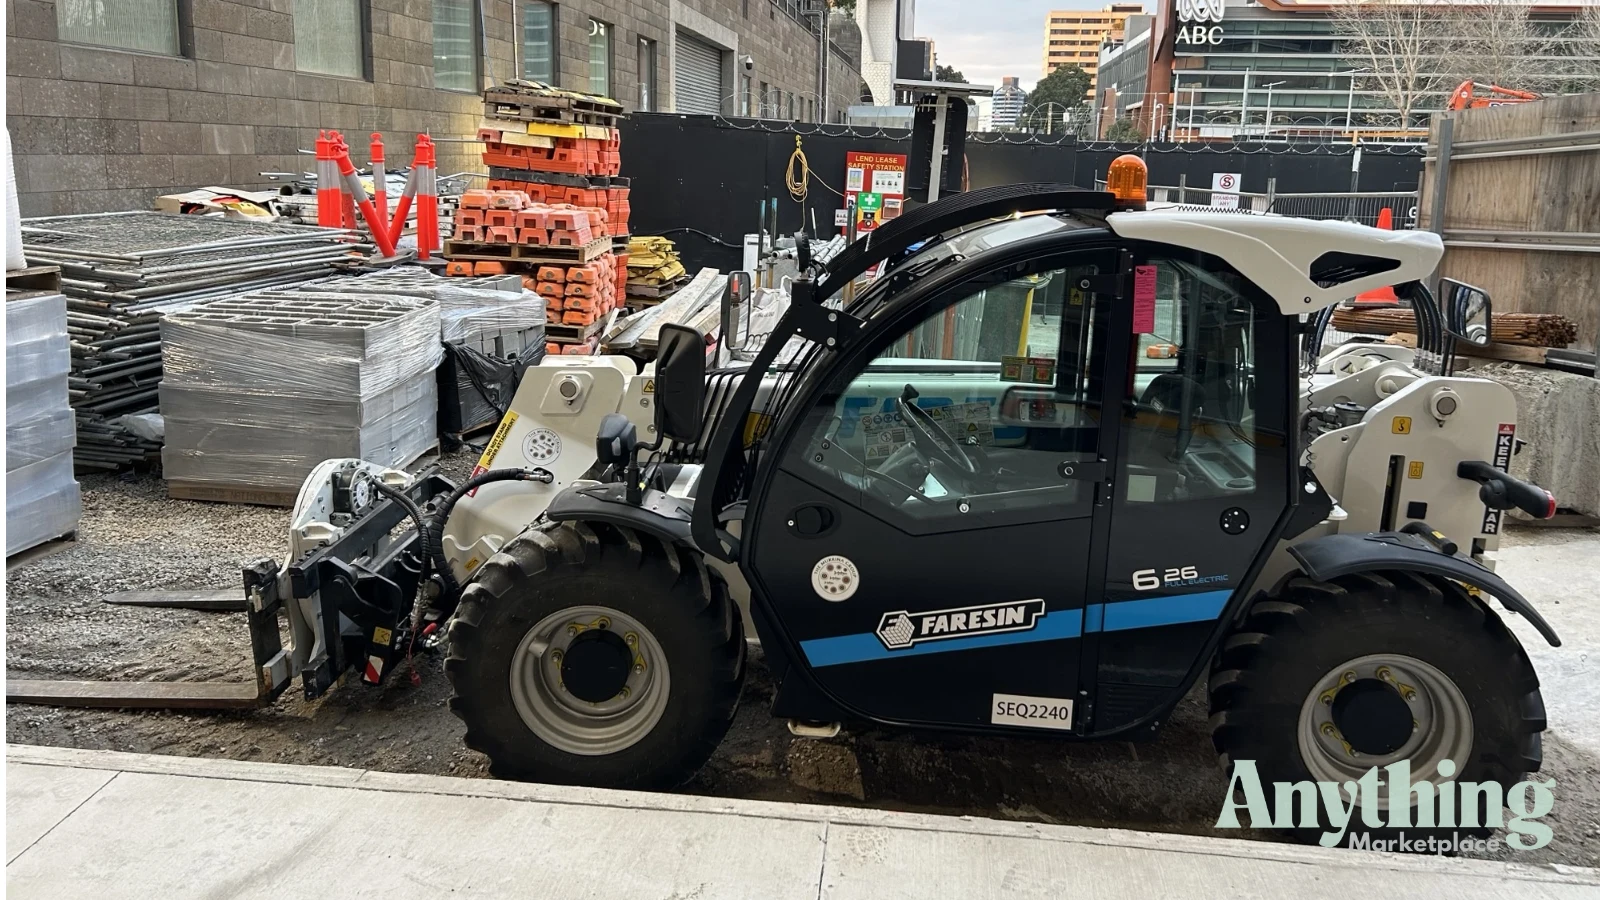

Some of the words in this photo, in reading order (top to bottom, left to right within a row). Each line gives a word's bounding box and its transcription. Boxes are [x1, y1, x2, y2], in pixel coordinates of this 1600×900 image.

[1175, 26, 1224, 45] ABC
[485, 448, 492, 456] DO
[489, 437, 498, 448] NOT
[496, 422, 507, 439] STAND
[486, 447, 498, 466] UNDER
[496, 417, 516, 448] ATTACHMENT
[1132, 568, 1160, 591] 6
[1163, 565, 1199, 582] 26
[1188, 574, 1229, 585] ELECTRIC
[920, 605, 1026, 636] FARESIN
[996, 701, 1069, 721] SEQ2240
